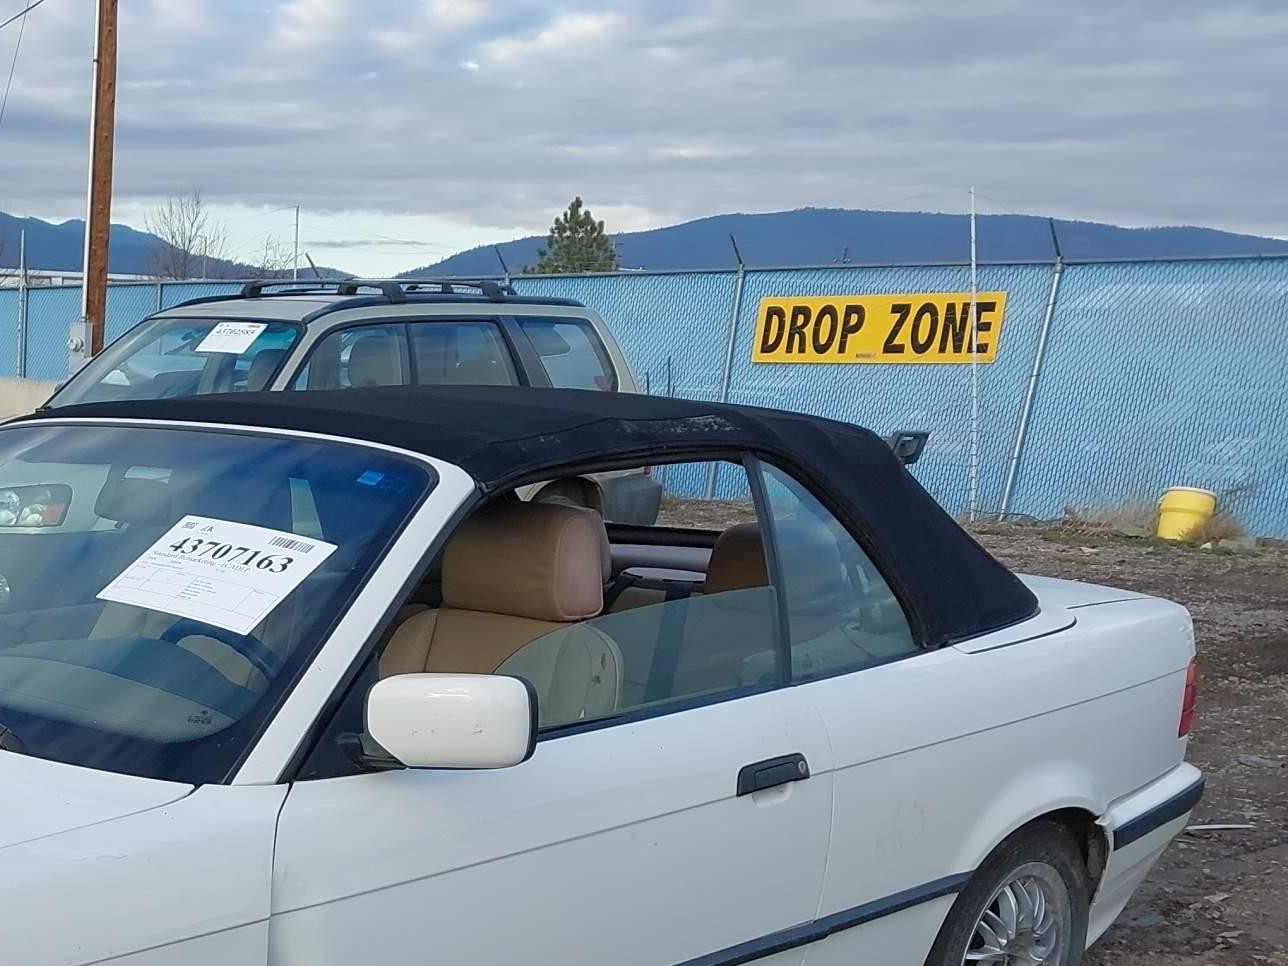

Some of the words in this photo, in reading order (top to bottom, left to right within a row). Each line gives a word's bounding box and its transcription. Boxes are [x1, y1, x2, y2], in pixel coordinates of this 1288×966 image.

[760, 304, 866, 355] DROP
[882, 301, 997, 354] ZONE
[169, 536, 295, 573] 43707163
